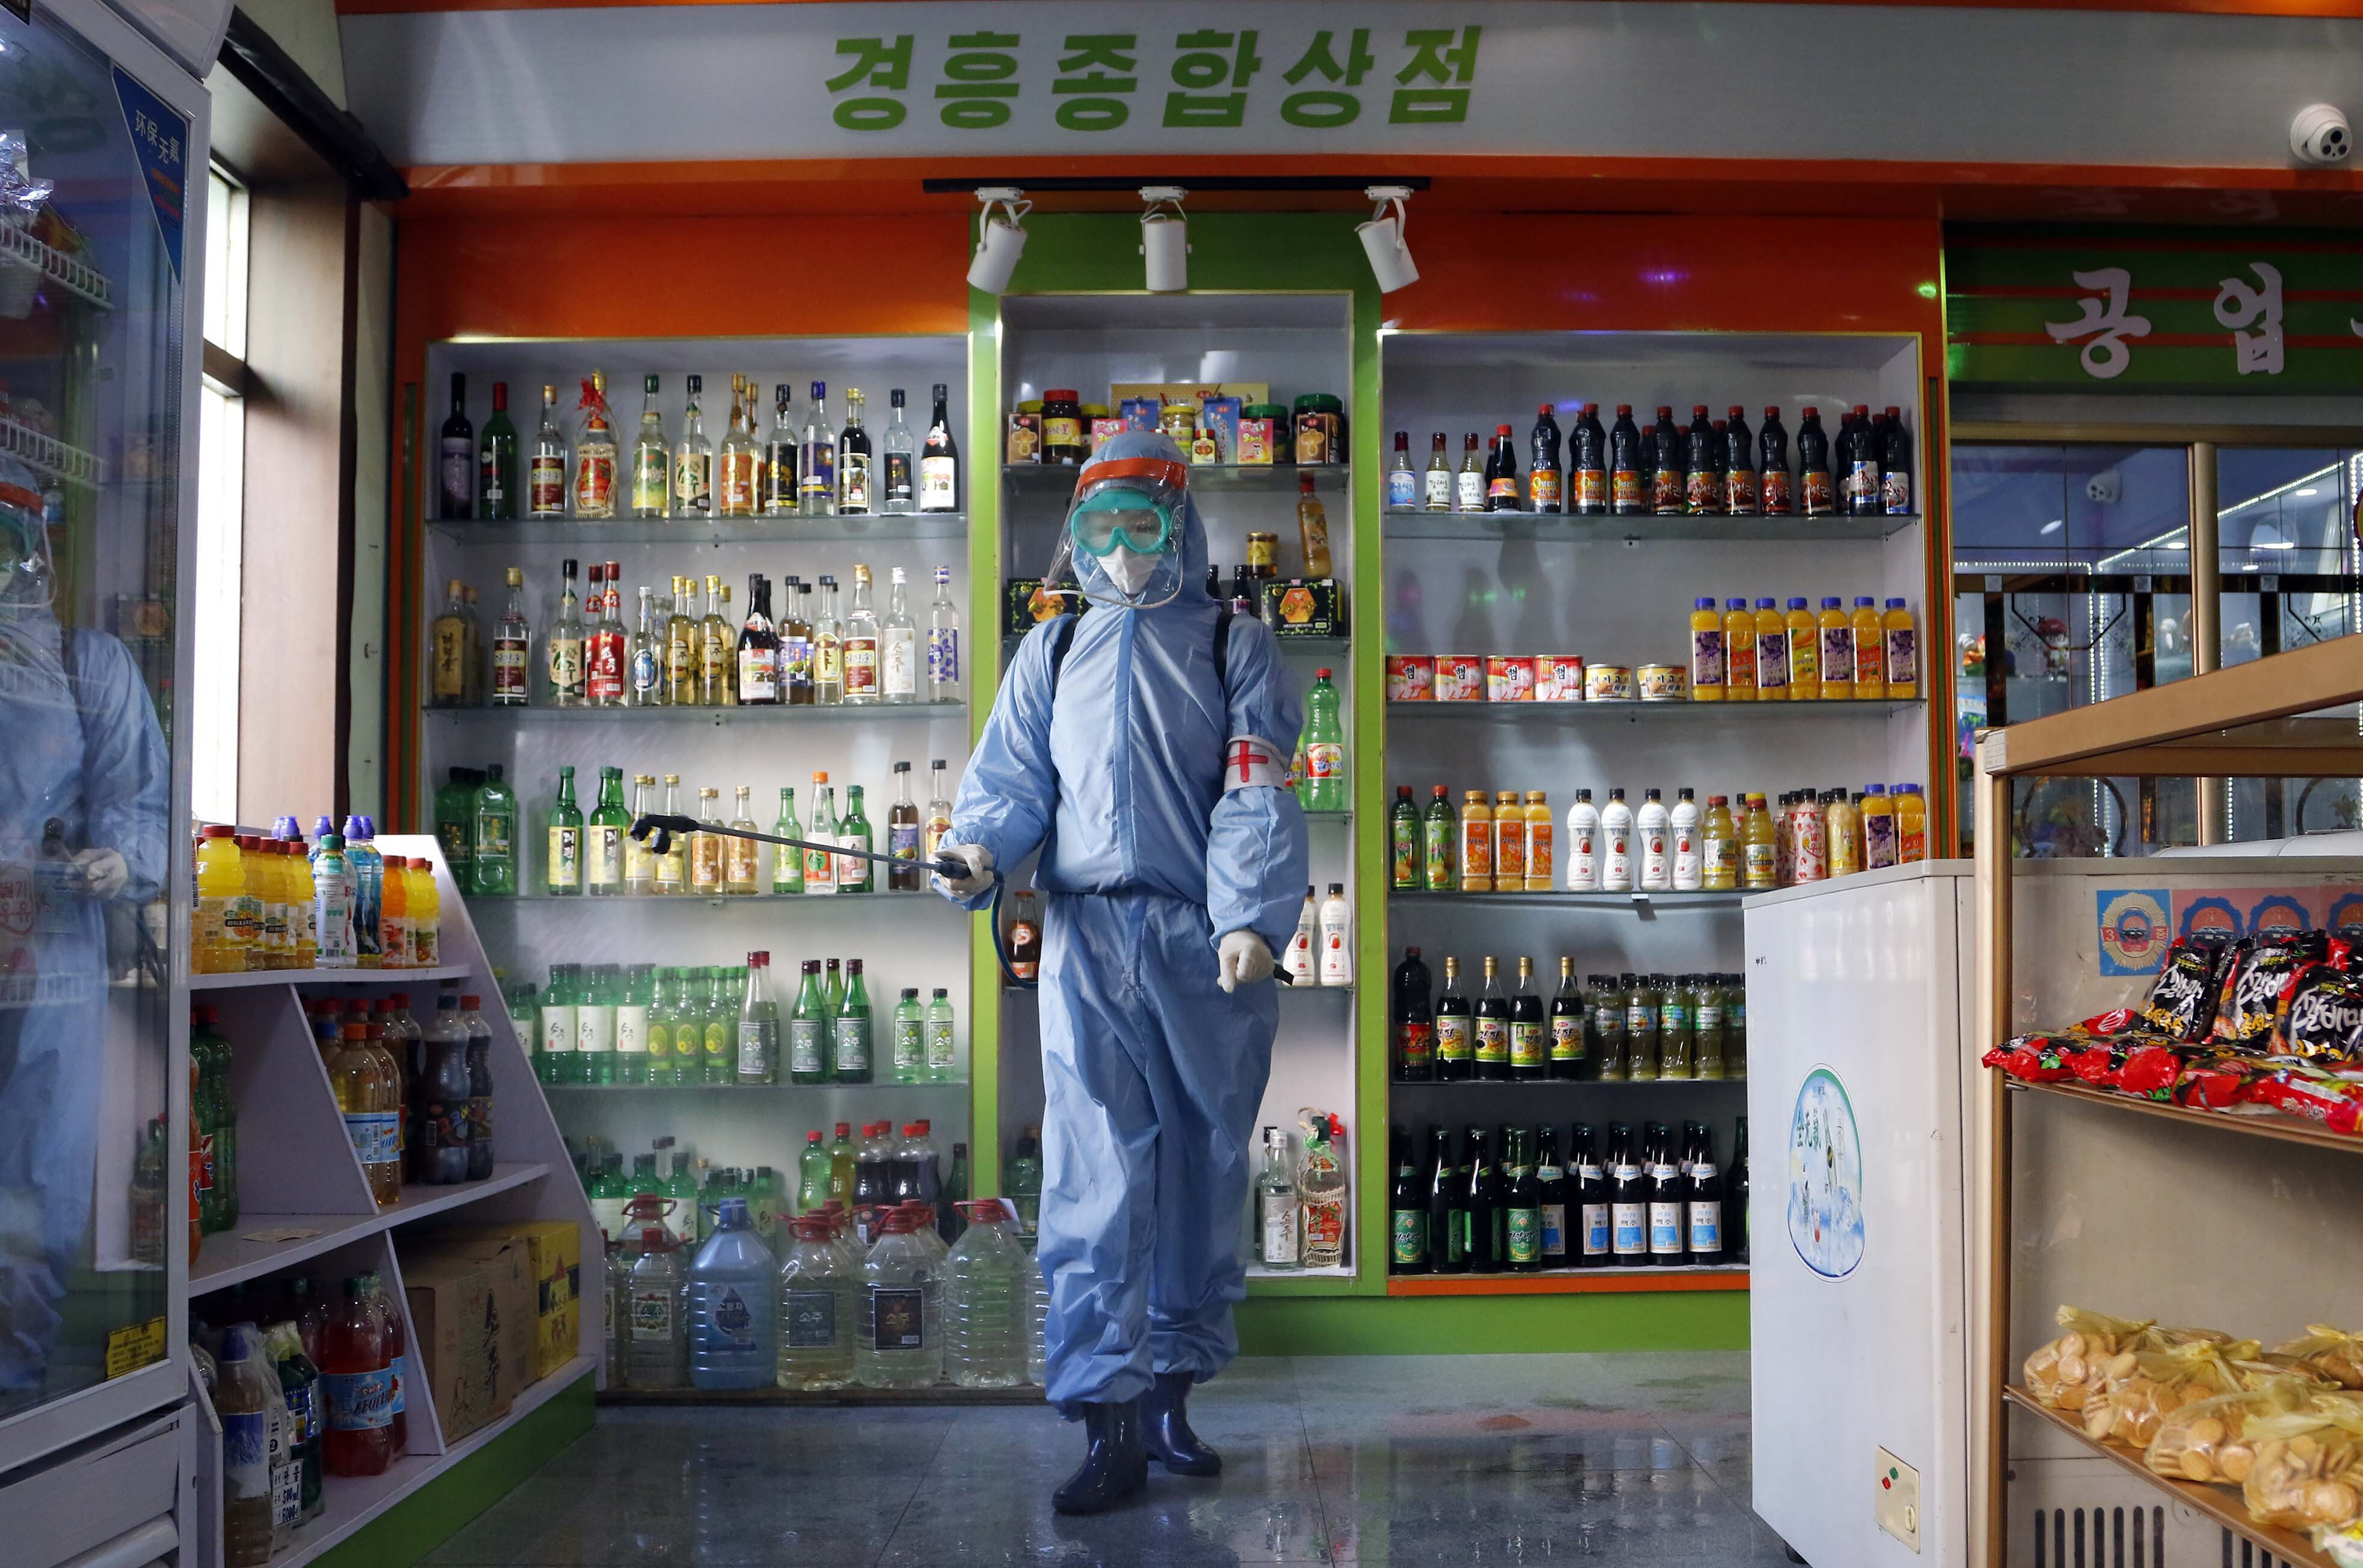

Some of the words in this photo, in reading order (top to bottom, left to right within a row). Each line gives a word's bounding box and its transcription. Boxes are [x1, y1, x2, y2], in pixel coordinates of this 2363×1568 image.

[825, 24, 1482, 131] 경흥종합상점
[2045, 262, 2363, 379] 공업
[600, 646, 616, 673] 소주
[1404, 665, 1415, 679] 햄
[1455, 665, 1465, 679] 햄
[1507, 666, 1517, 680] 햄
[1554, 665, 1565, 679] 햄
[1811, 833, 1822, 842] 딸기
[1810, 843, 1822, 853] 우유
[2107, 930, 2114, 941] 3
[1437, 1028, 1454, 1039] 간장
[1479, 1031, 1501, 1041] 간장
[1553, 1029, 1573, 1039] 간장
[796, 1039, 813, 1049] 소주
[842, 1037, 860, 1047] 소주
[901, 1036, 918, 1046] 소주
[936, 1036, 952, 1046] 소주
[1524, 1035, 1542, 1044] 간장
[745, 1041, 761, 1052] 소주
[1279, 1210, 1292, 1241] 소주
[640, 1305, 664, 1318] 소주
[798, 1312, 823, 1323] 소주
[885, 1312, 909, 1325] 소주
